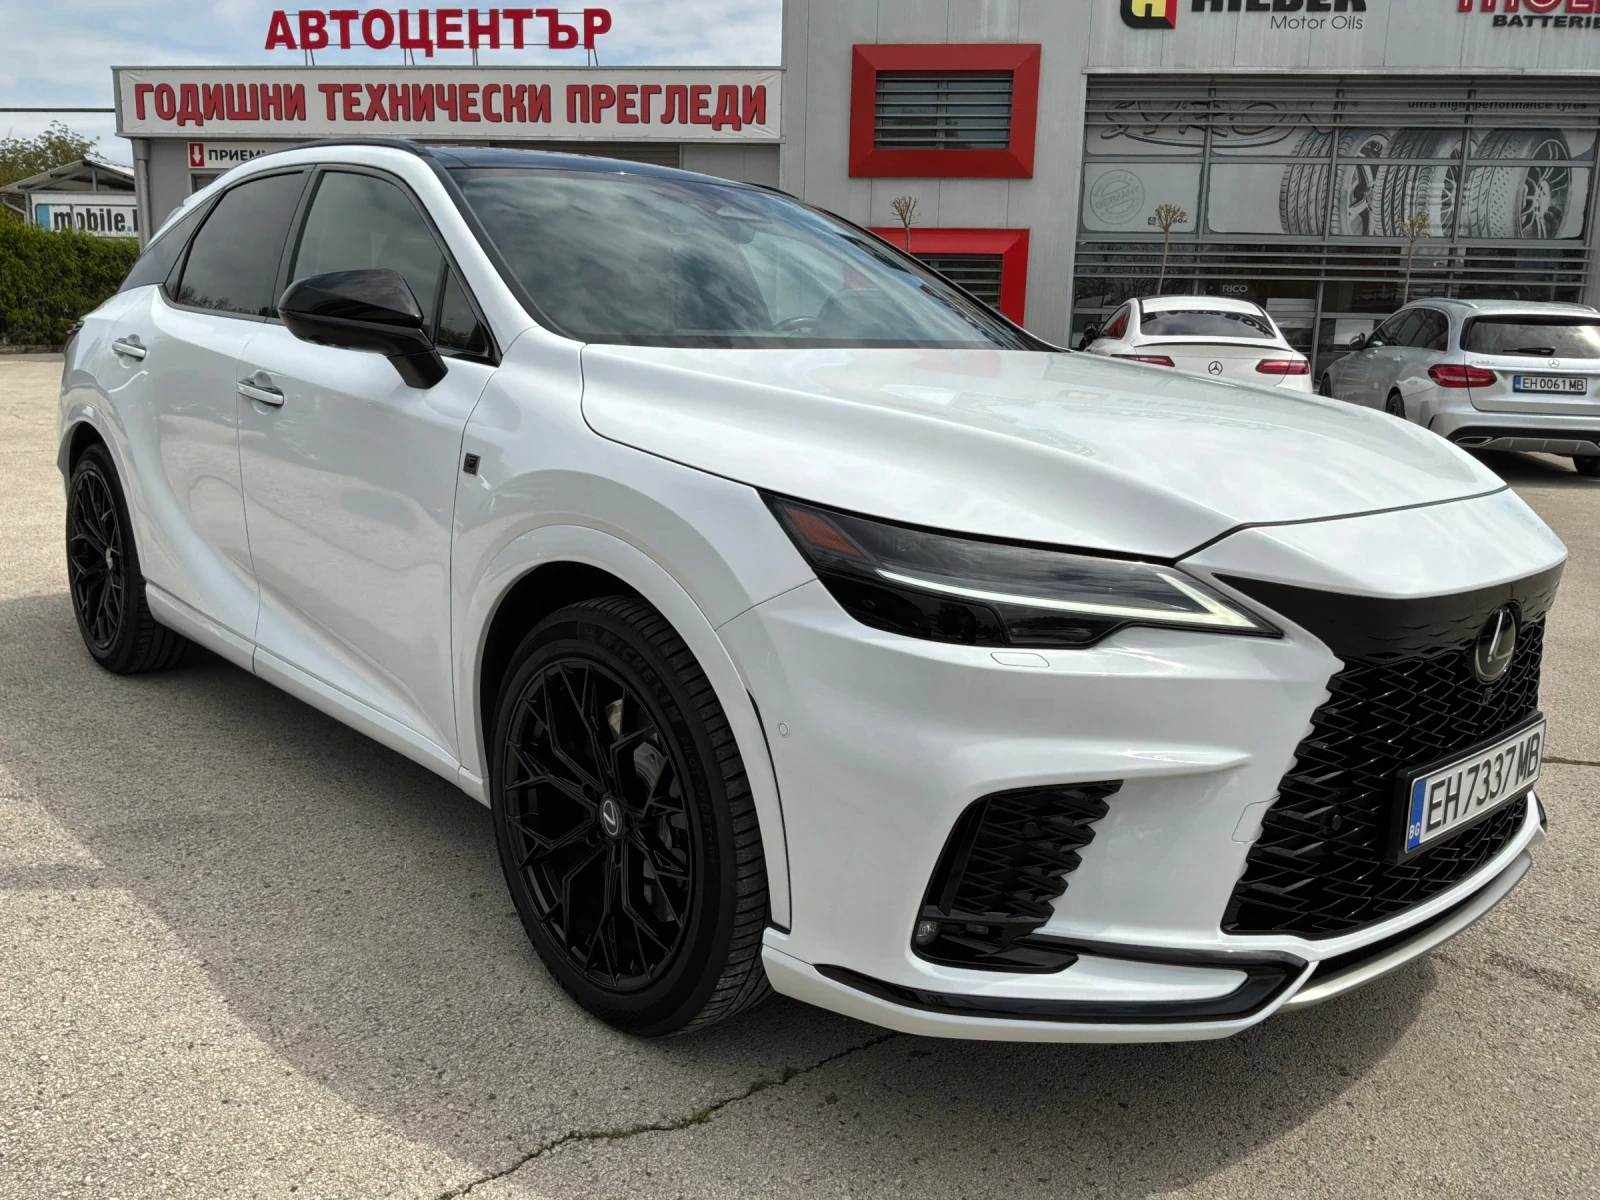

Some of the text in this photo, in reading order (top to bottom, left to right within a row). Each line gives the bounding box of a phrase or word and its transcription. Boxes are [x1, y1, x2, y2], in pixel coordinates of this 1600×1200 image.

[1270, 15, 1363, 30] Motor Oils
[265, 9, 612, 57] АВТОЦЕНТЪР
[135, 83, 766, 131] ГОДИШНИ ТЕХНИЧЕСКИ ПРЕГЛЕДИ
[208, 149, 265, 161] ПРИЕМ
[1222, 285, 1248, 293] RICO
[1409, 822, 1421, 840] BG
